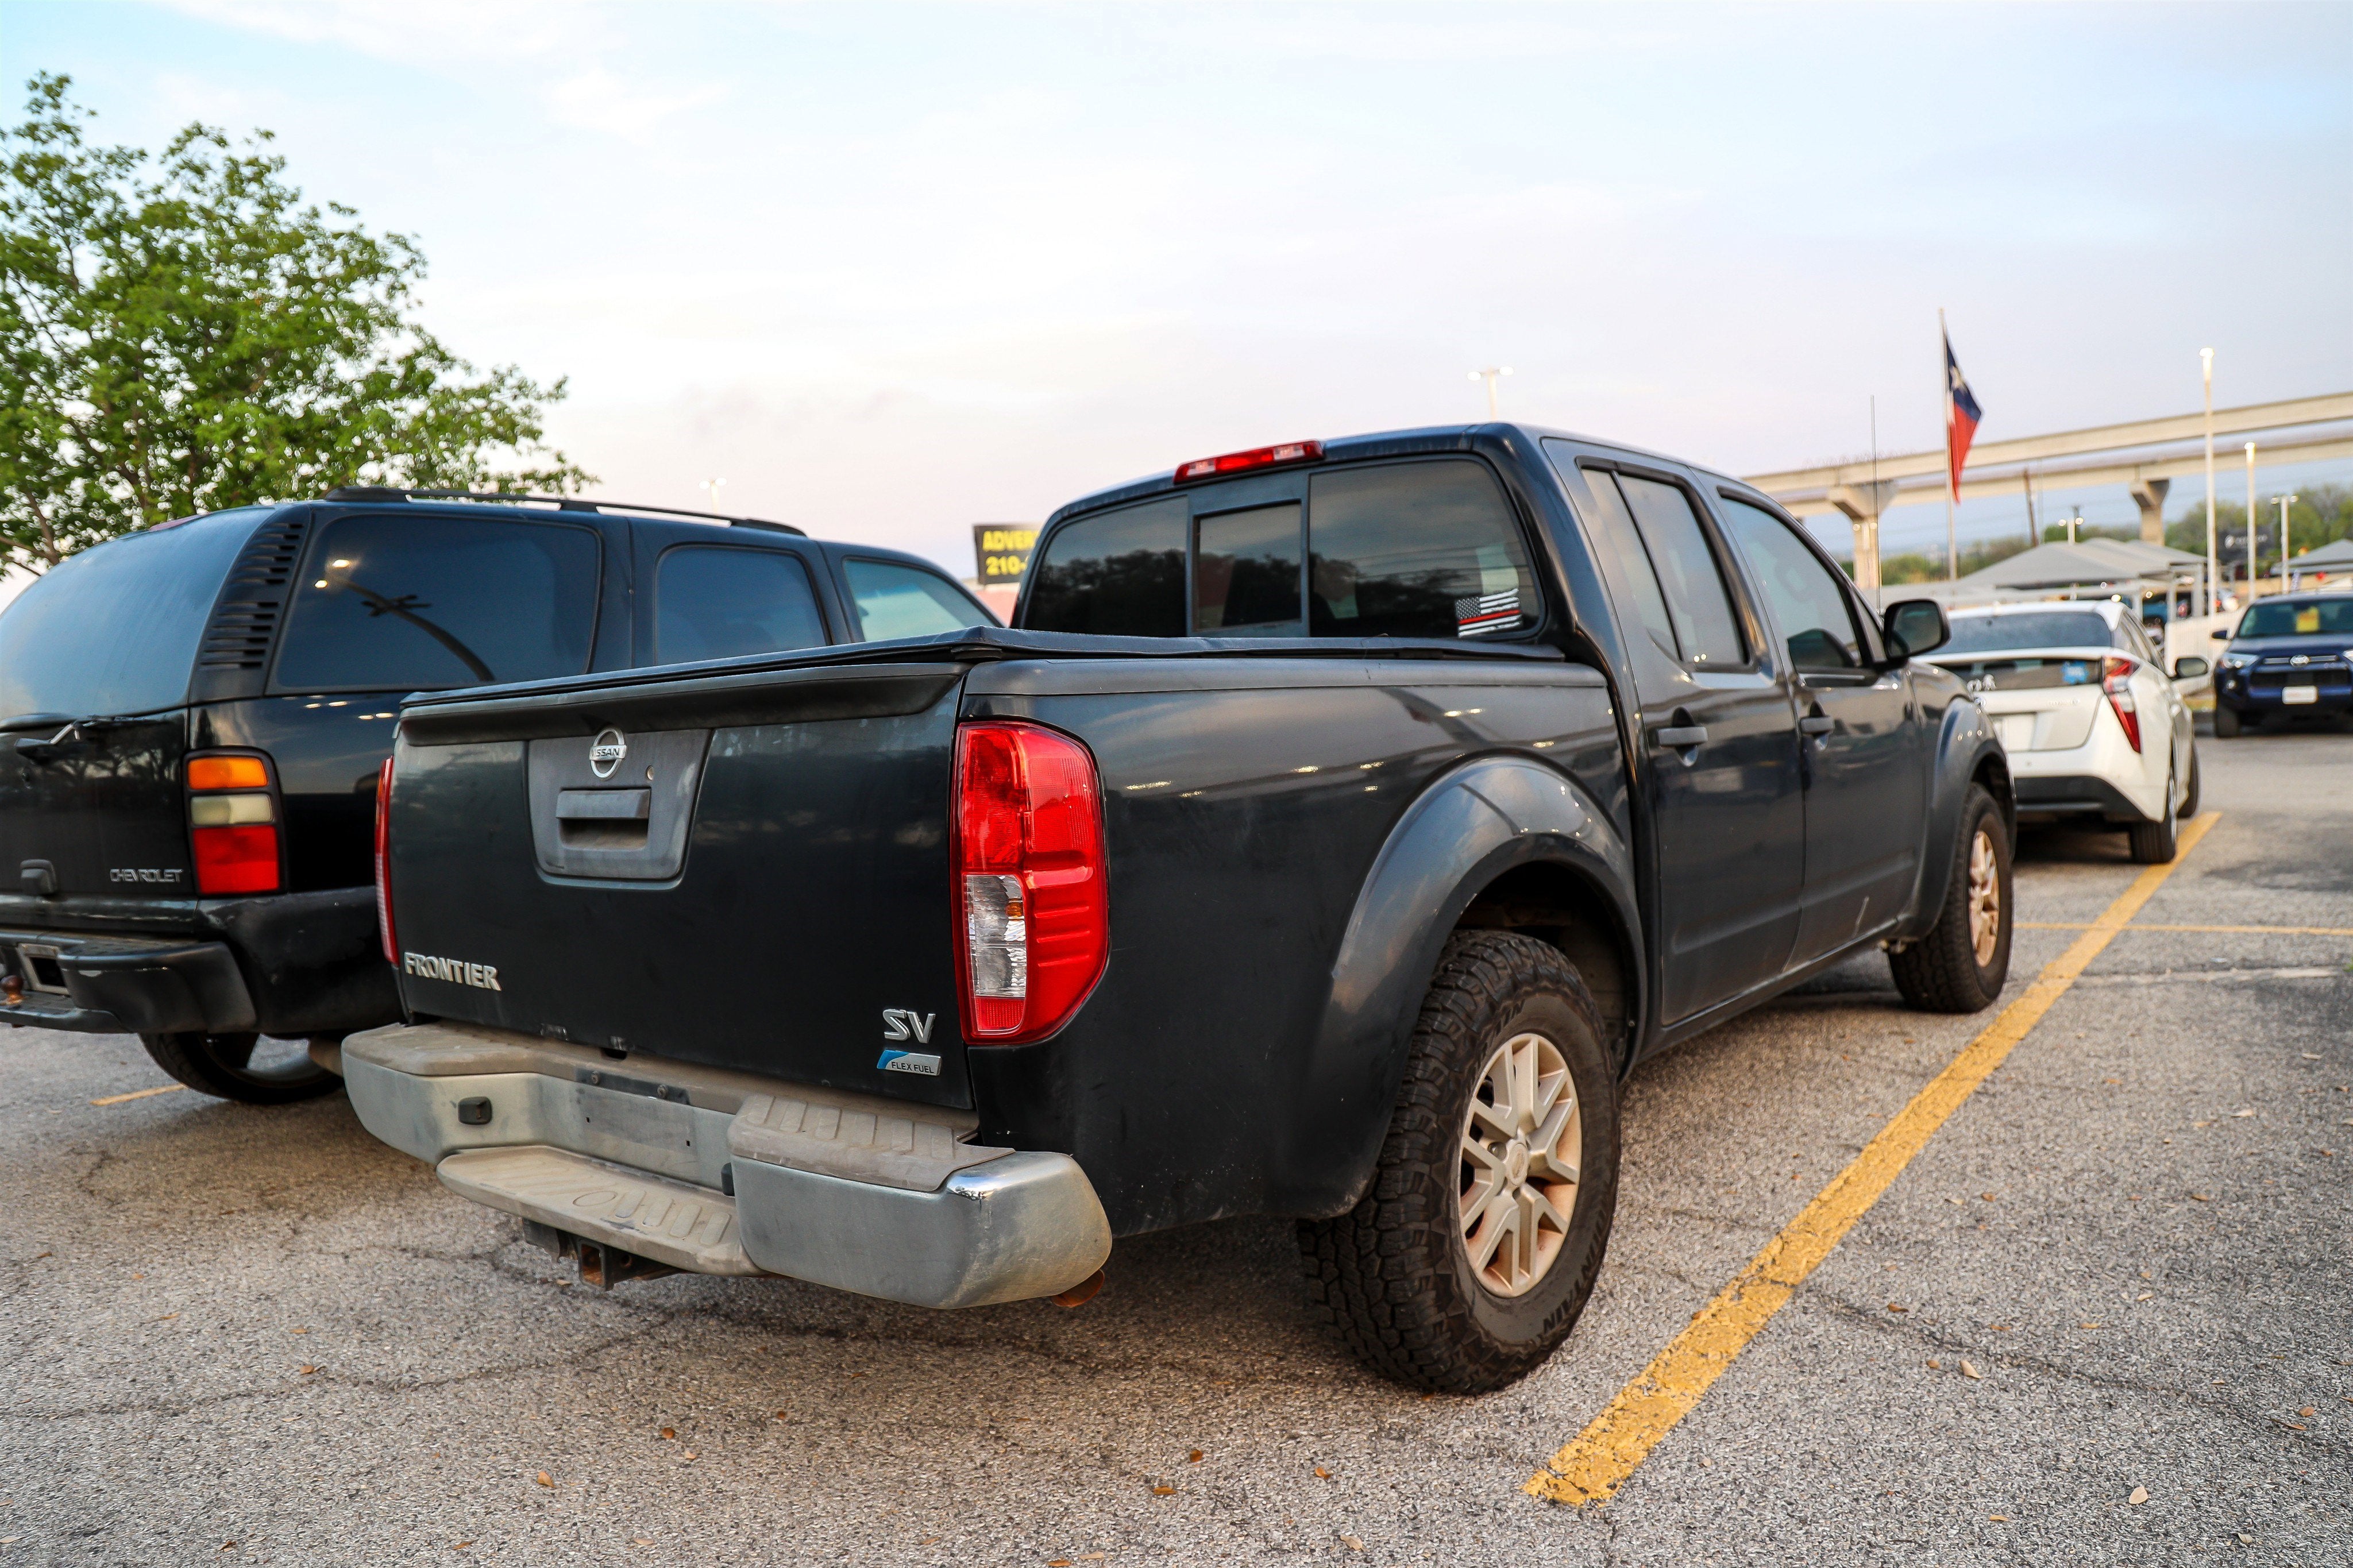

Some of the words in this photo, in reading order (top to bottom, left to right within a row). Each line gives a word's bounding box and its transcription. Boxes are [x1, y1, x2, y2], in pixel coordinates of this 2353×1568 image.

[982, 530, 1038, 552] ADVER
[590, 748, 620, 758] NISSAN
[109, 868, 184, 883] CHEVROLET
[404, 951, 502, 991] FRONTIER
[882, 1009, 936, 1044] SV
[891, 1061, 913, 1071] FLEX
[913, 1064, 935, 1074] FUEL
